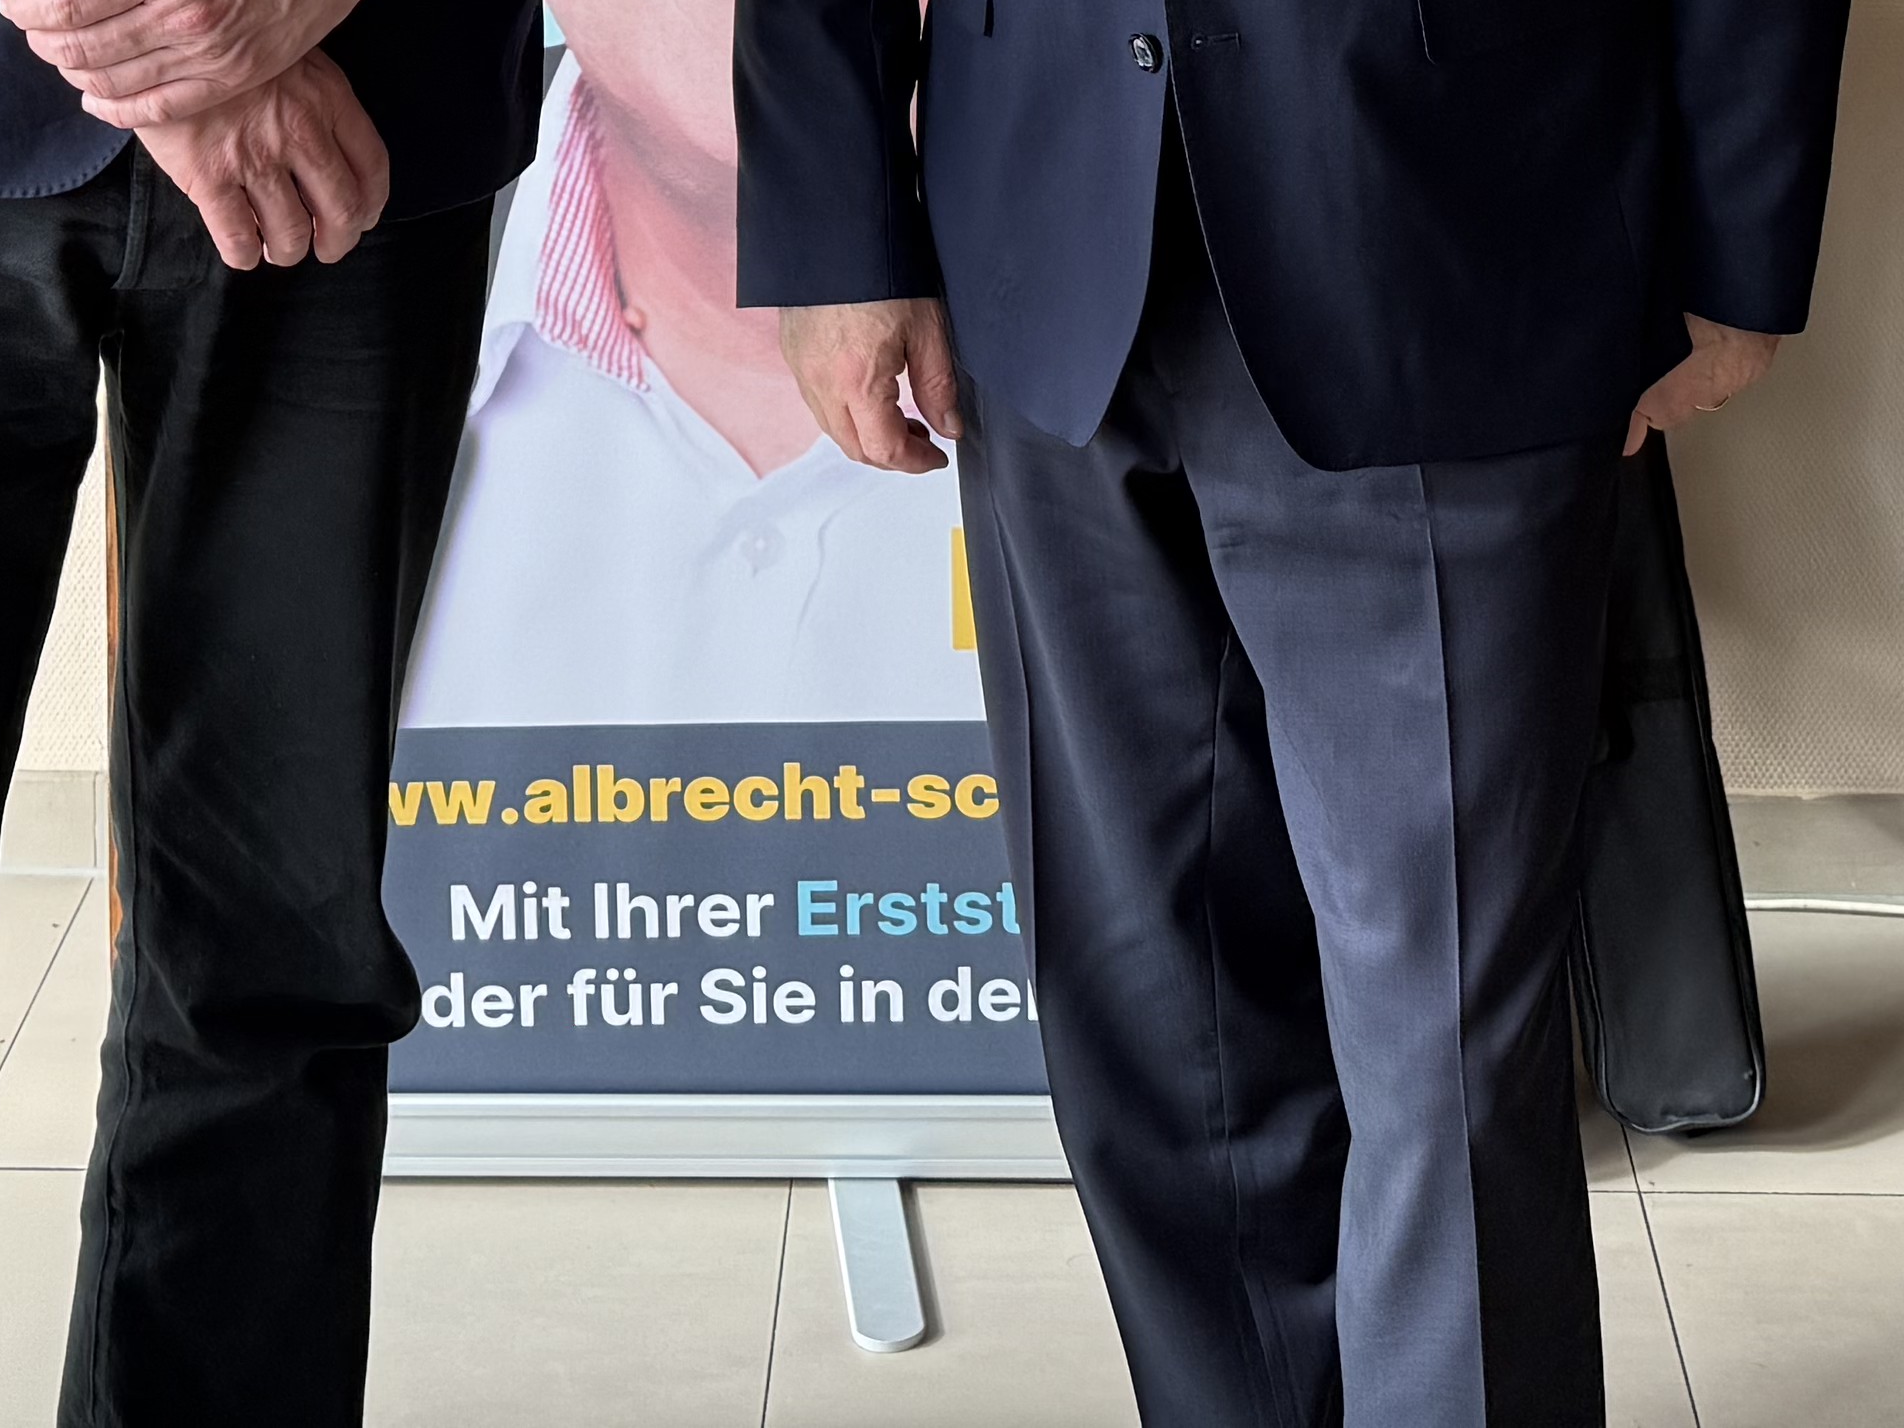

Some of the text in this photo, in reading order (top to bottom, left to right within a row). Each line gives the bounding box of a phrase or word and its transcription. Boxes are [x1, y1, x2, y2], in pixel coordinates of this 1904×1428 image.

[450, 880, 572, 941] Mit
[594, 882, 775, 939] Ihrer
[421, 971, 548, 1028] der
[566, 967, 679, 1027] für
[699, 965, 816, 1025] Sie
[839, 964, 904, 1023] in
